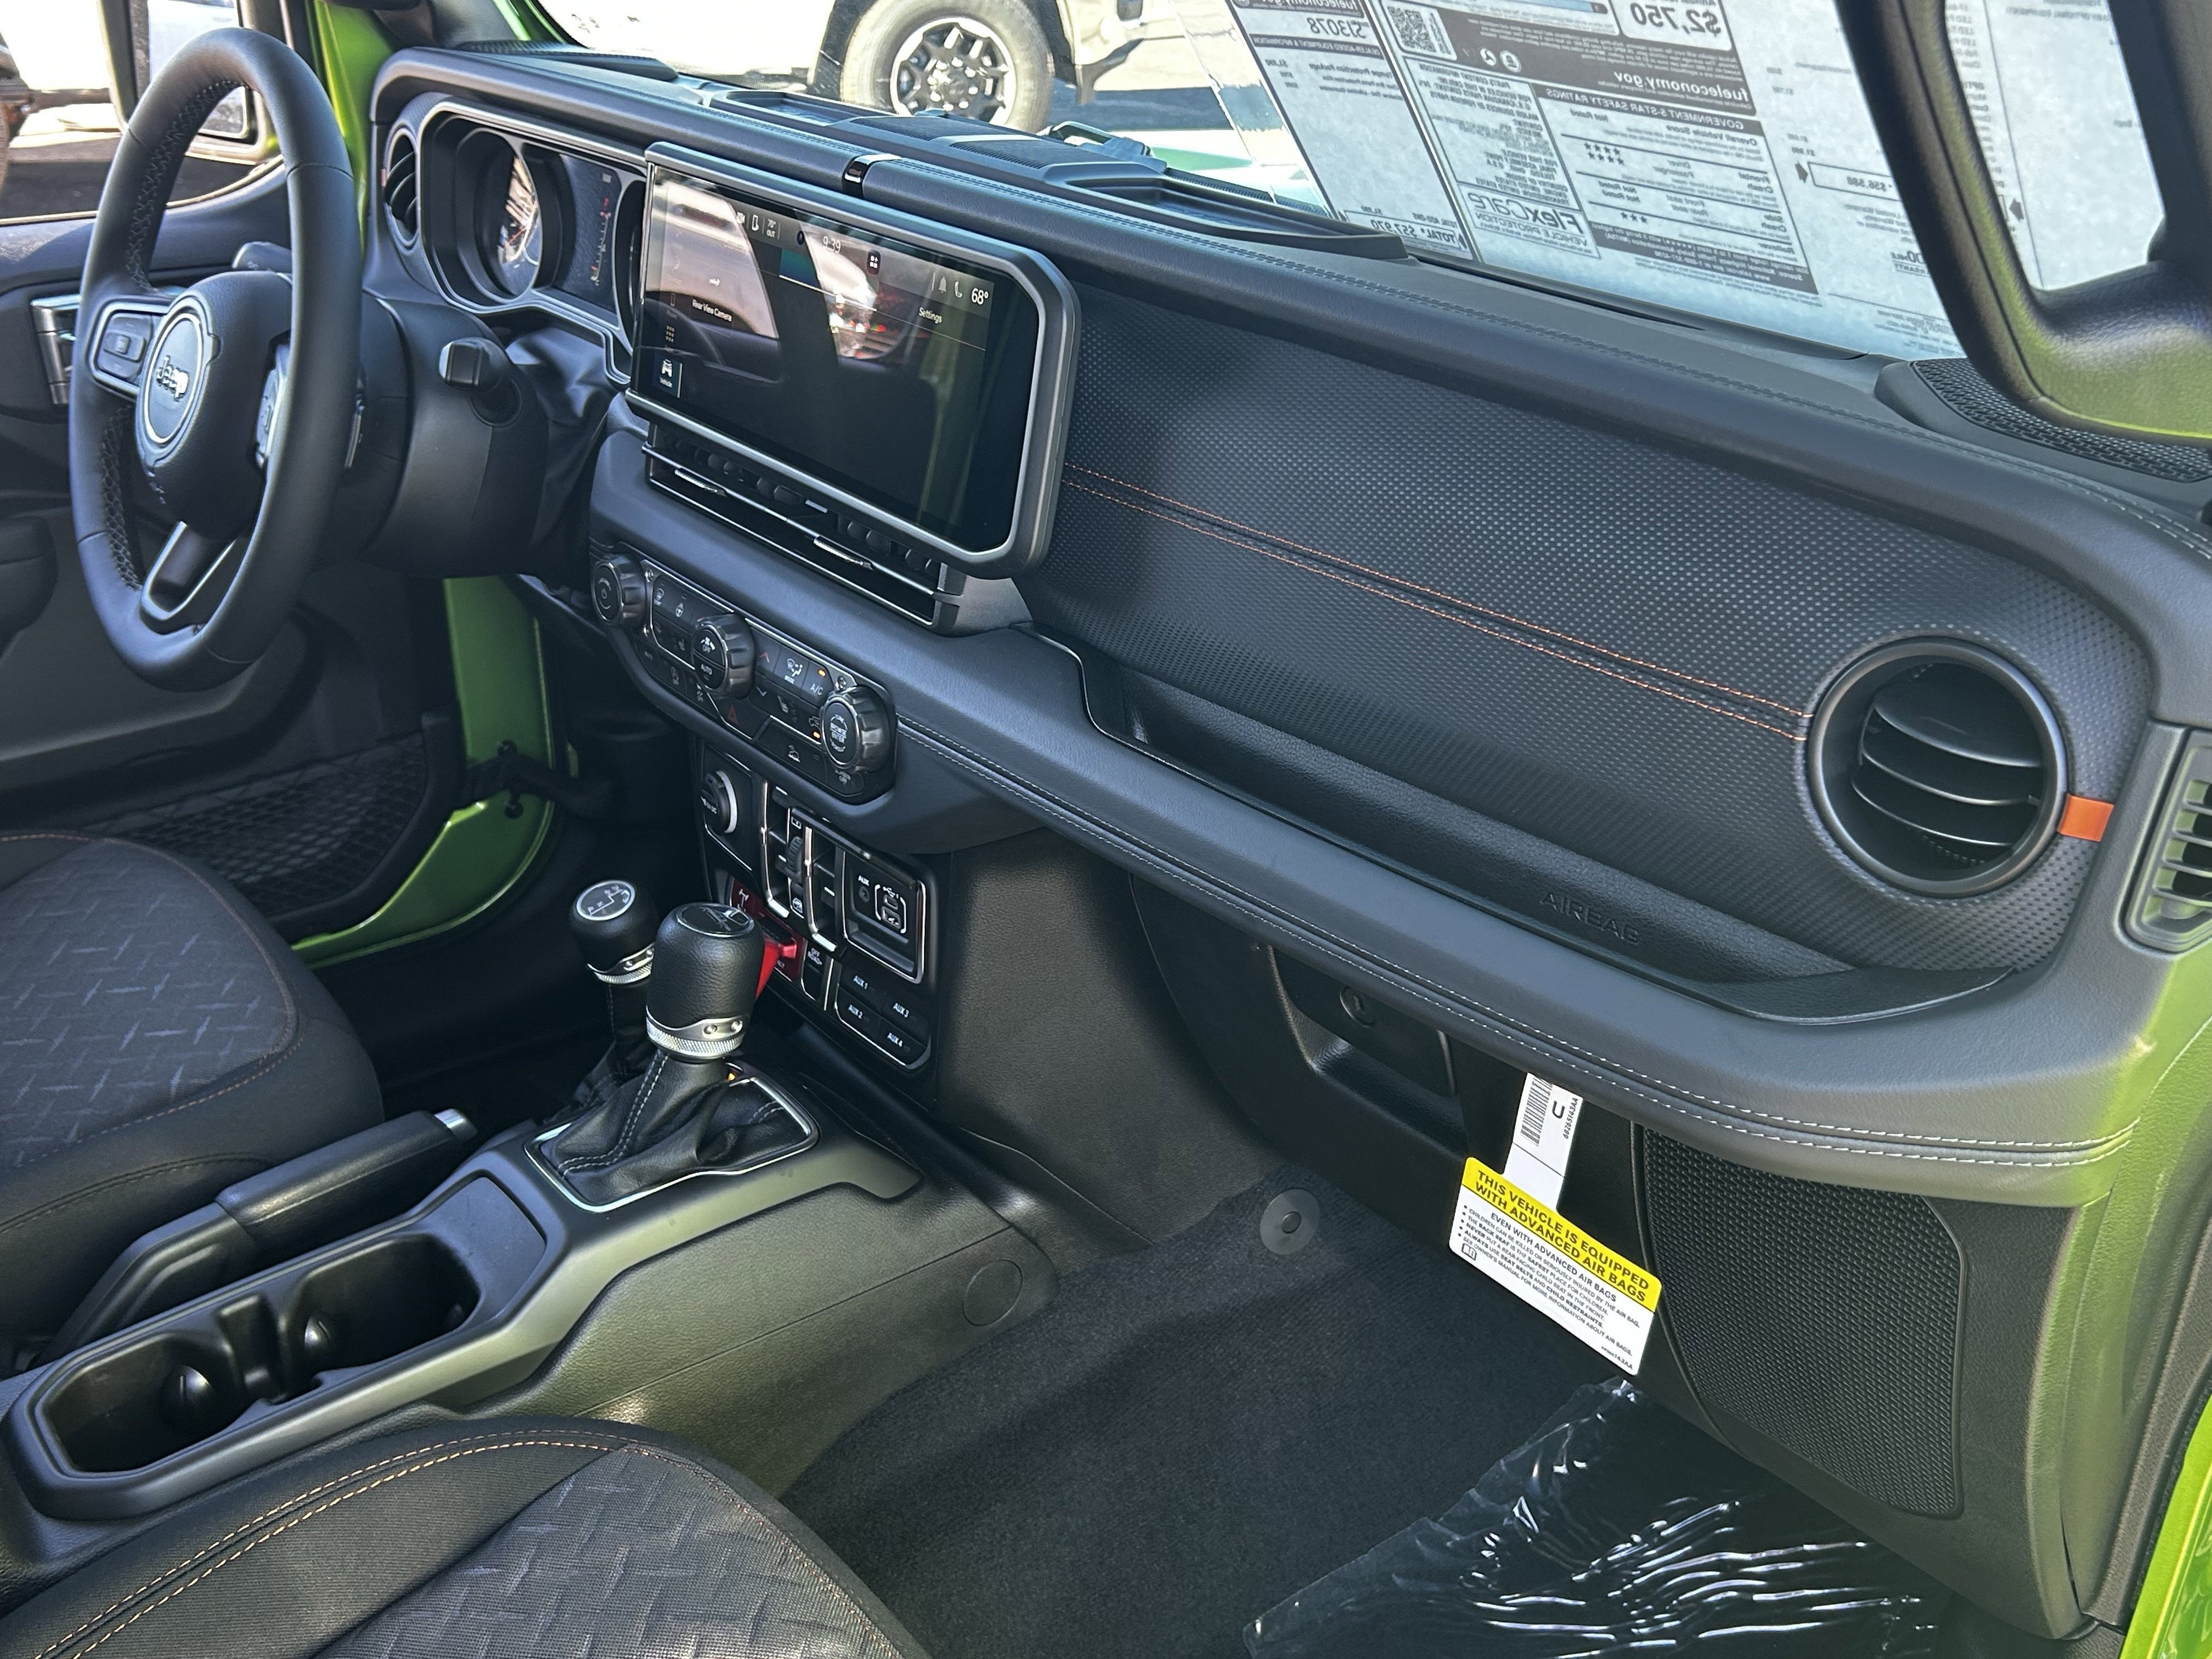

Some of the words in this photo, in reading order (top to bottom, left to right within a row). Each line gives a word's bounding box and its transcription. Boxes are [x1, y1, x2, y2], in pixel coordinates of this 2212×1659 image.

[823, 236, 841, 253] 9:39
[692, 299, 703, 310] Rear
[703, 303, 714, 314] View
[714, 308, 732, 322] Camera
[918, 307, 943, 324] Settings
[701, 663, 713, 675] AUTO
[810, 684, 823, 695] A/C
[858, 875, 870, 887] AUX
[853, 975, 865, 987] AUX
[848, 1005, 859, 1016] AUX
[893, 1003, 905, 1015] AUX
[887, 1032, 899, 1044] AUX
[1476, 1169, 1506, 1197] THIS
[1508, 1189, 1563, 1235] VEHICLE
[1565, 1228, 1578, 1245] IS
[1580, 1238, 1650, 1293] EQUIPPED
[1474, 1181, 1508, 1210] WITH
[1509, 1204, 1581, 1260] ADVANCED
[1582, 1254, 1606, 1277] AIR
[1608, 1271, 1646, 1304] BAGS
[1466, 1222, 1485, 1239] NEVER
[1486, 1235, 1496, 1246] PUT
[1502, 1246, 1536, 1273] REAR-FACING
[1536, 1269, 1553, 1285] CHILD
[1553, 1282, 1566, 1295] SEAT
[1566, 1291, 1573, 1300] IN
[1574, 1296, 1584, 1307] THE
[1468, 1215, 1477, 1226] THE
[1479, 1222, 1494, 1237] BACK
[1495, 1233, 1510, 1248] SEAT
[1516, 1248, 1526, 1259] THE
[1527, 1256, 1549, 1274] SAFEST
[1549, 1271, 1567, 1286] PLACE
[1567, 1283, 1578, 1295] FOR
[1579, 1291, 1609, 1316] CHILDREN.
[1469, 1207, 1495, 1229] CHILDREN
[1495, 1226, 1506, 1238] CAN
[1508, 1234, 1515, 1243] BE
[1515, 1239, 1533, 1256] KILLED
[1534, 1252, 1542, 1261] OR
[1543, 1258, 1572, 1282] SERIOUSLY
[1572, 1278, 1595, 1298] INJURED
[1595, 1294, 1603, 1304] BY
[1604, 1300, 1615, 1312] THE
[1616, 1308, 1626, 1319] AIR
[1490, 1212, 1511, 1231] EVEN
[1512, 1226, 1533, 1245] WITH
[1534, 1242, 1578, 1276] ADVANCED
[1578, 1272, 1593, 1287] AIR
[1594, 1282, 1617, 1303] BAGS
[1464, 1229, 1488, 1249] ALWAYS
[1489, 1246, 1499, 1257] USE
[1500, 1254, 1515, 1267] SEAT
[1515, 1264, 1533, 1280] BELTS
[1533, 1277, 1545, 1288] AND
[1546, 1285, 1565, 1302] CHILD
[1565, 1299, 1604, 1329] RESTRAINTS.
[1463, 1235, 1472, 1246] SEE
[1498, 1260, 1520, 1279] MANUAL
[1521, 1276, 1532, 1286] FOR
[1532, 1284, 1548, 1298] MORE
[1548, 1295, 1585, 1324] INFORMATION
[1585, 1321, 1605, 1338] ABOUT
[1605, 1334, 1615, 1345] AIR
